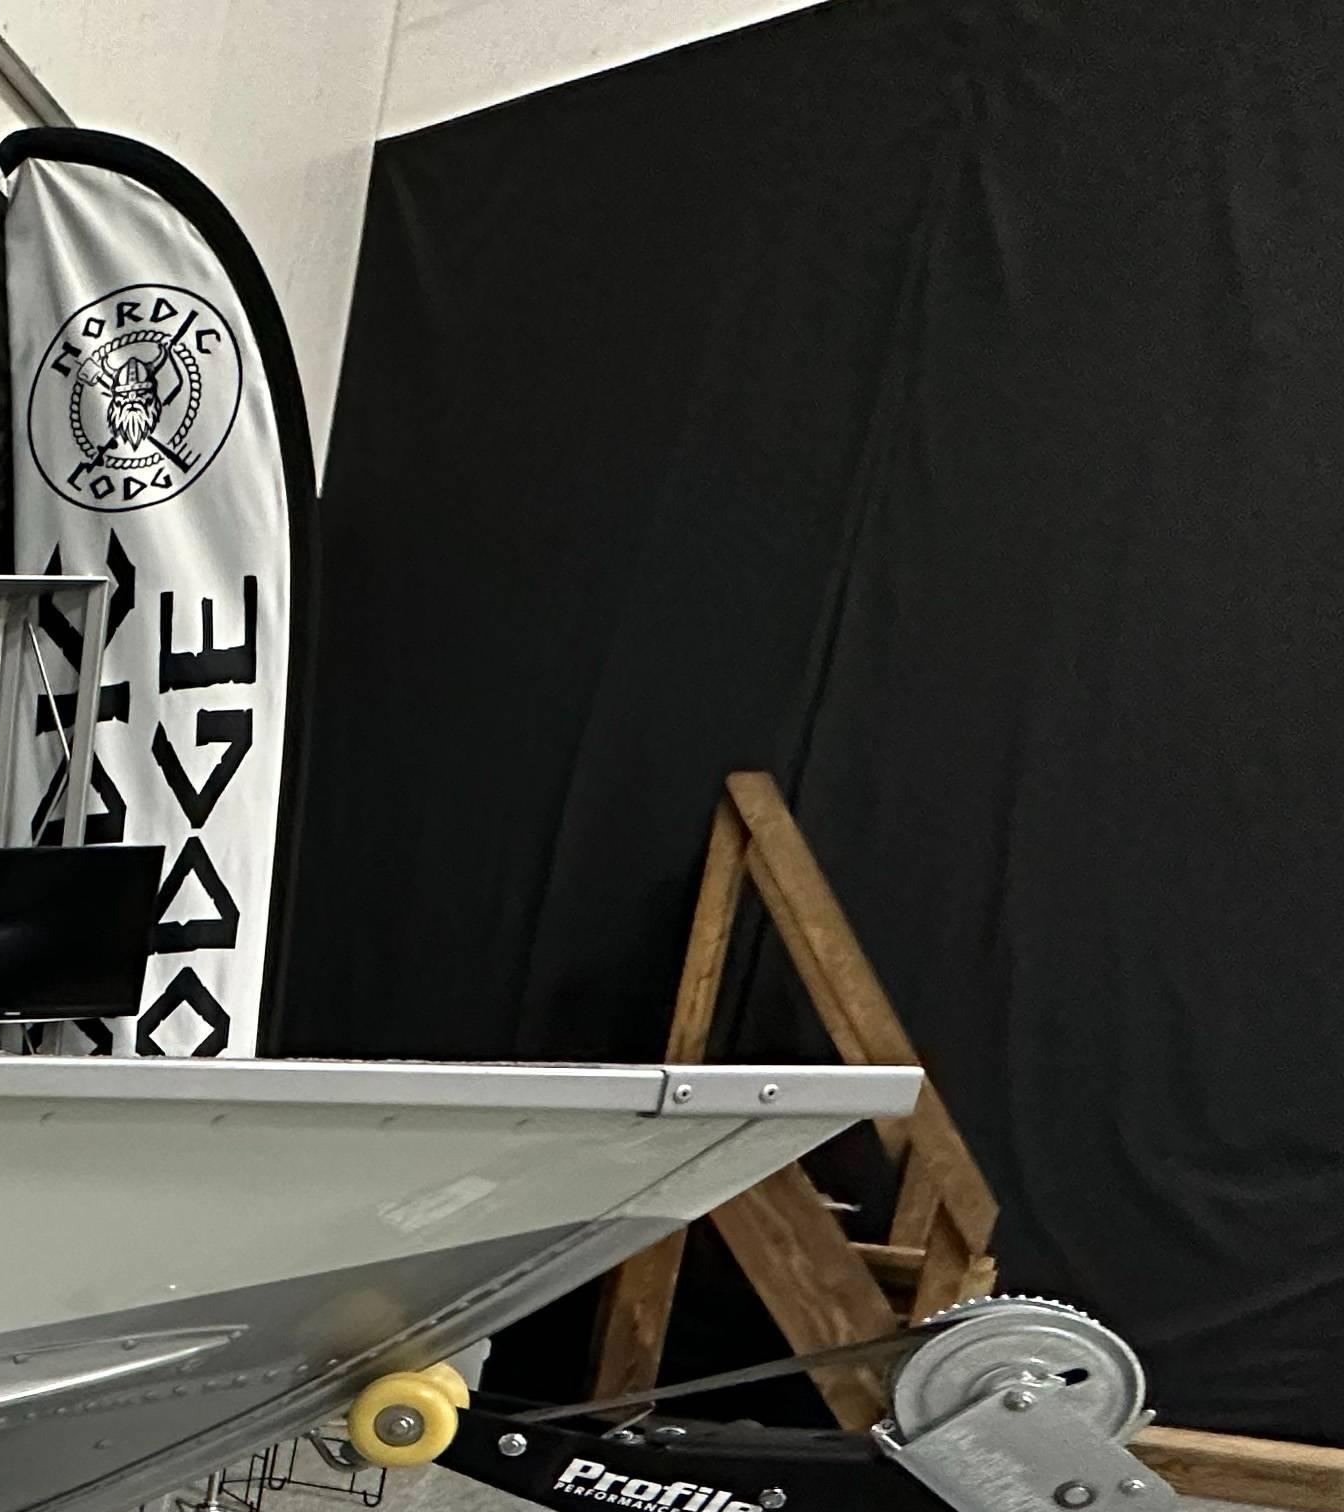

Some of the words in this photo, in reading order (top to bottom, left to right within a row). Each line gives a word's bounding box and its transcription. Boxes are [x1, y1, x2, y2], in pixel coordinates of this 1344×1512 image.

[51, 298, 221, 378] NORDIC
[67, 443, 202, 501] LODGE
[136, 575, 258, 1058] ODGE
